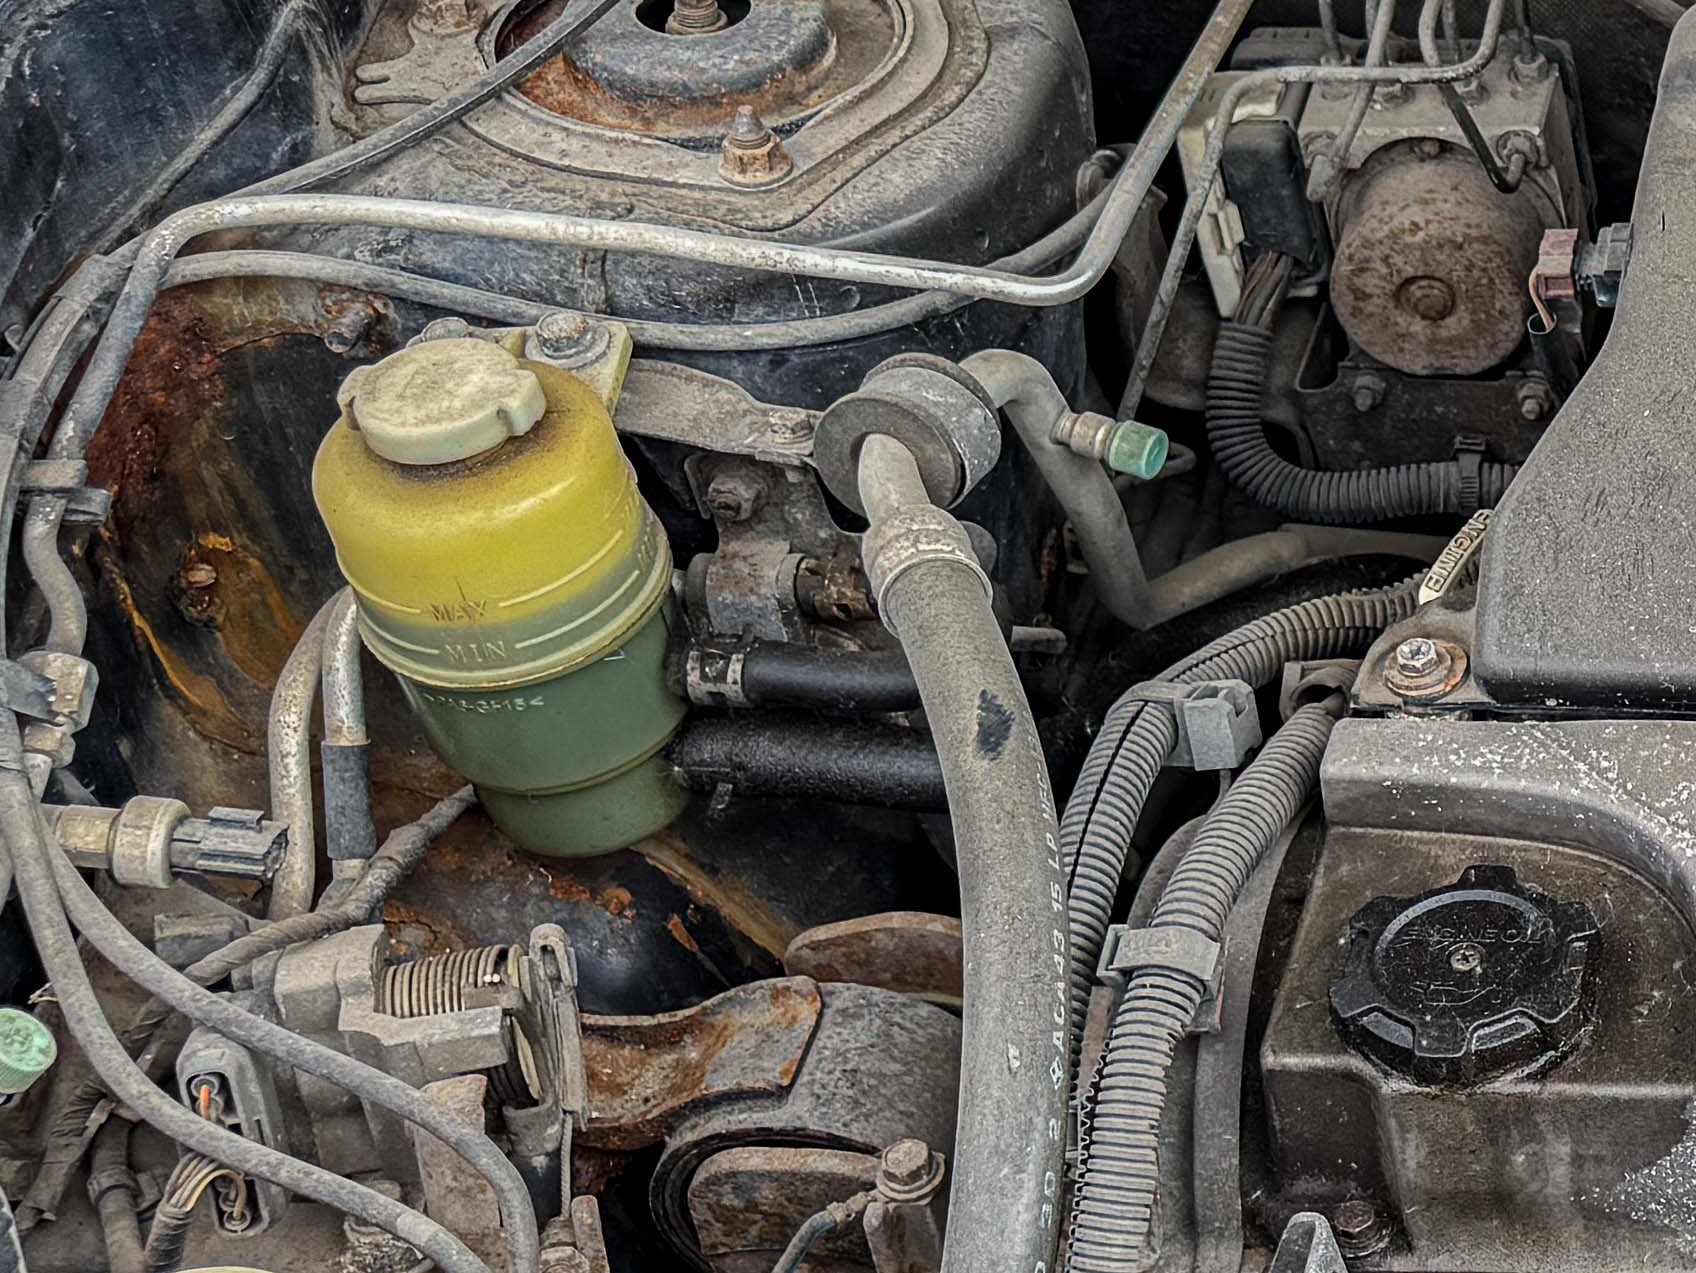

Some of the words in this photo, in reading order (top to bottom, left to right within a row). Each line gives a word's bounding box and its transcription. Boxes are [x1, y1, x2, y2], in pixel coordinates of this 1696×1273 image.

[430, 600, 487, 622] MAX
[445, 640, 506, 664] MIN
[1045, 832, 1060, 870] LP
[1049, 881, 1064, 912] 15
